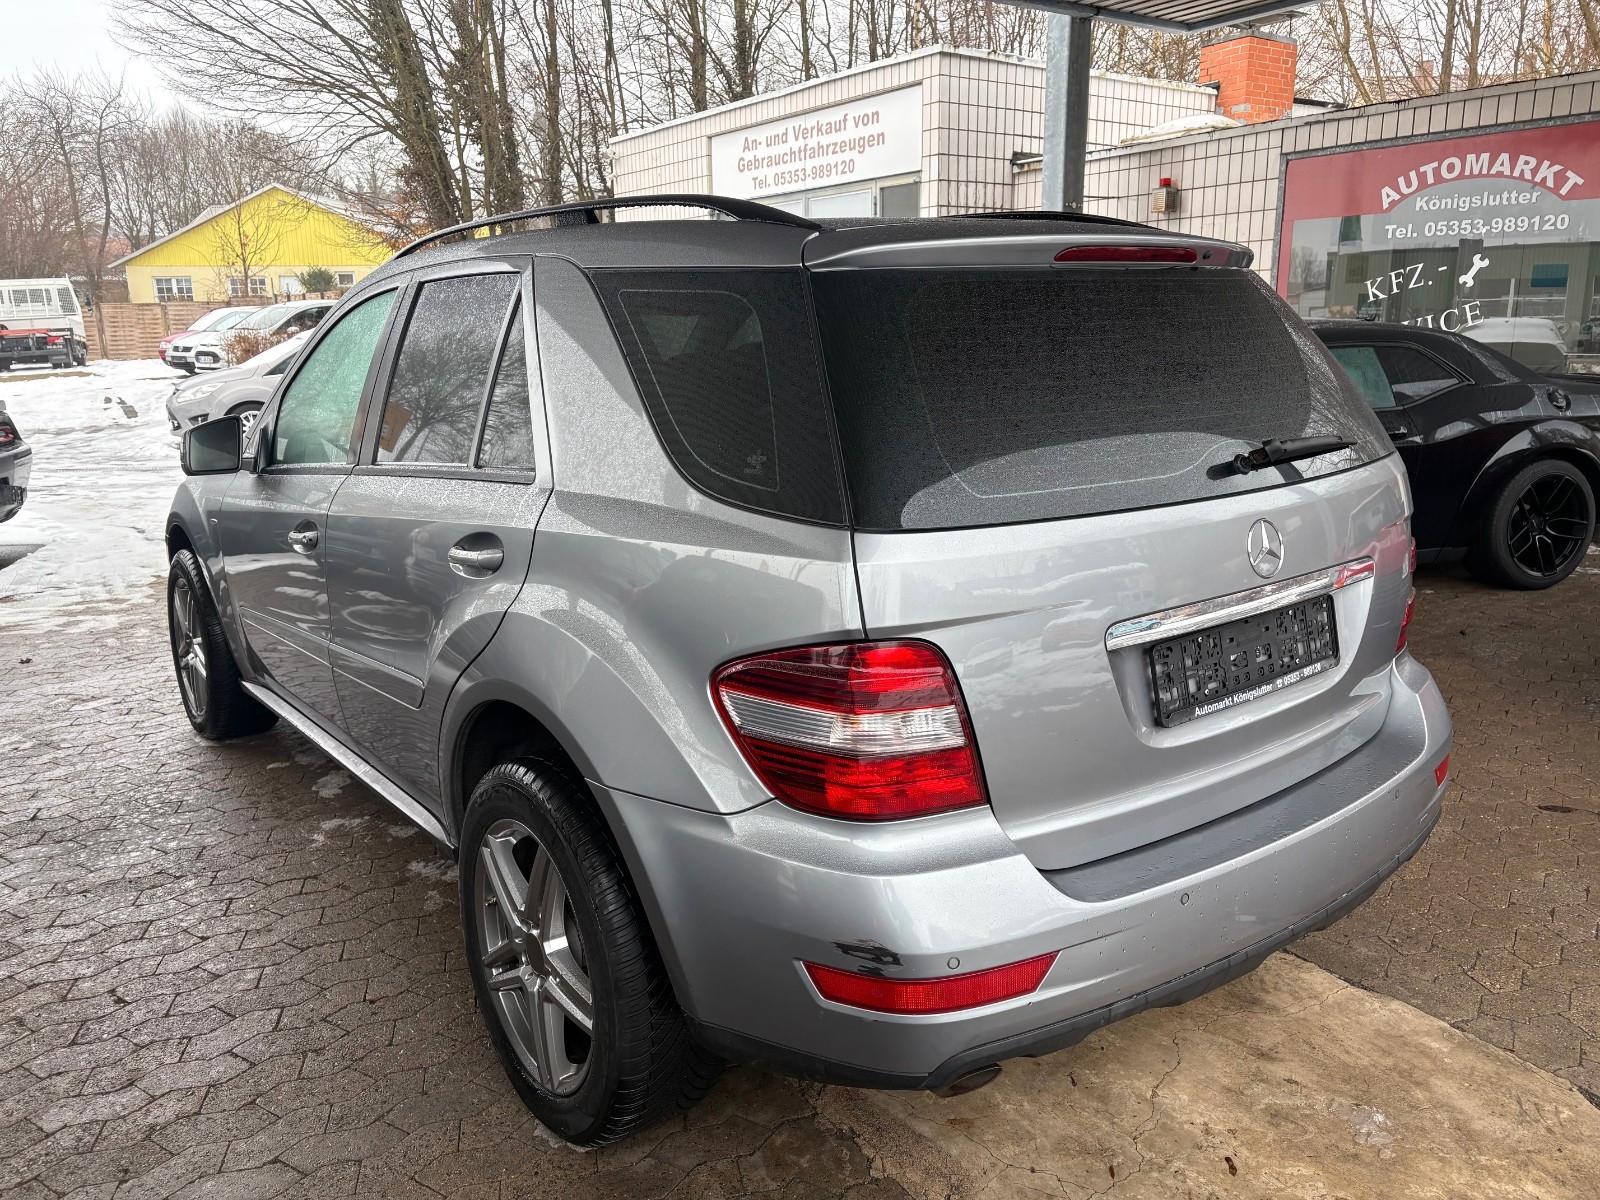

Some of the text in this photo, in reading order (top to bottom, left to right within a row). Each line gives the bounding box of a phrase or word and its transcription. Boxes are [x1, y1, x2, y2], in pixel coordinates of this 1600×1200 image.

[742, 110, 880, 153] An- und Verkauf von
[737, 131, 886, 173] Gebrauchtfahrzeugen
[752, 158, 855, 190] Tel. 05353-989120
[1380, 152, 1585, 209] AUTOMARKT
[1415, 189, 1541, 212] Königslutter
[1385, 214, 1570, 239] Tel. 05353-989120
[1194, 696, 1233, 717] Automarkt
[1233, 683, 1273, 701] Königslutter
